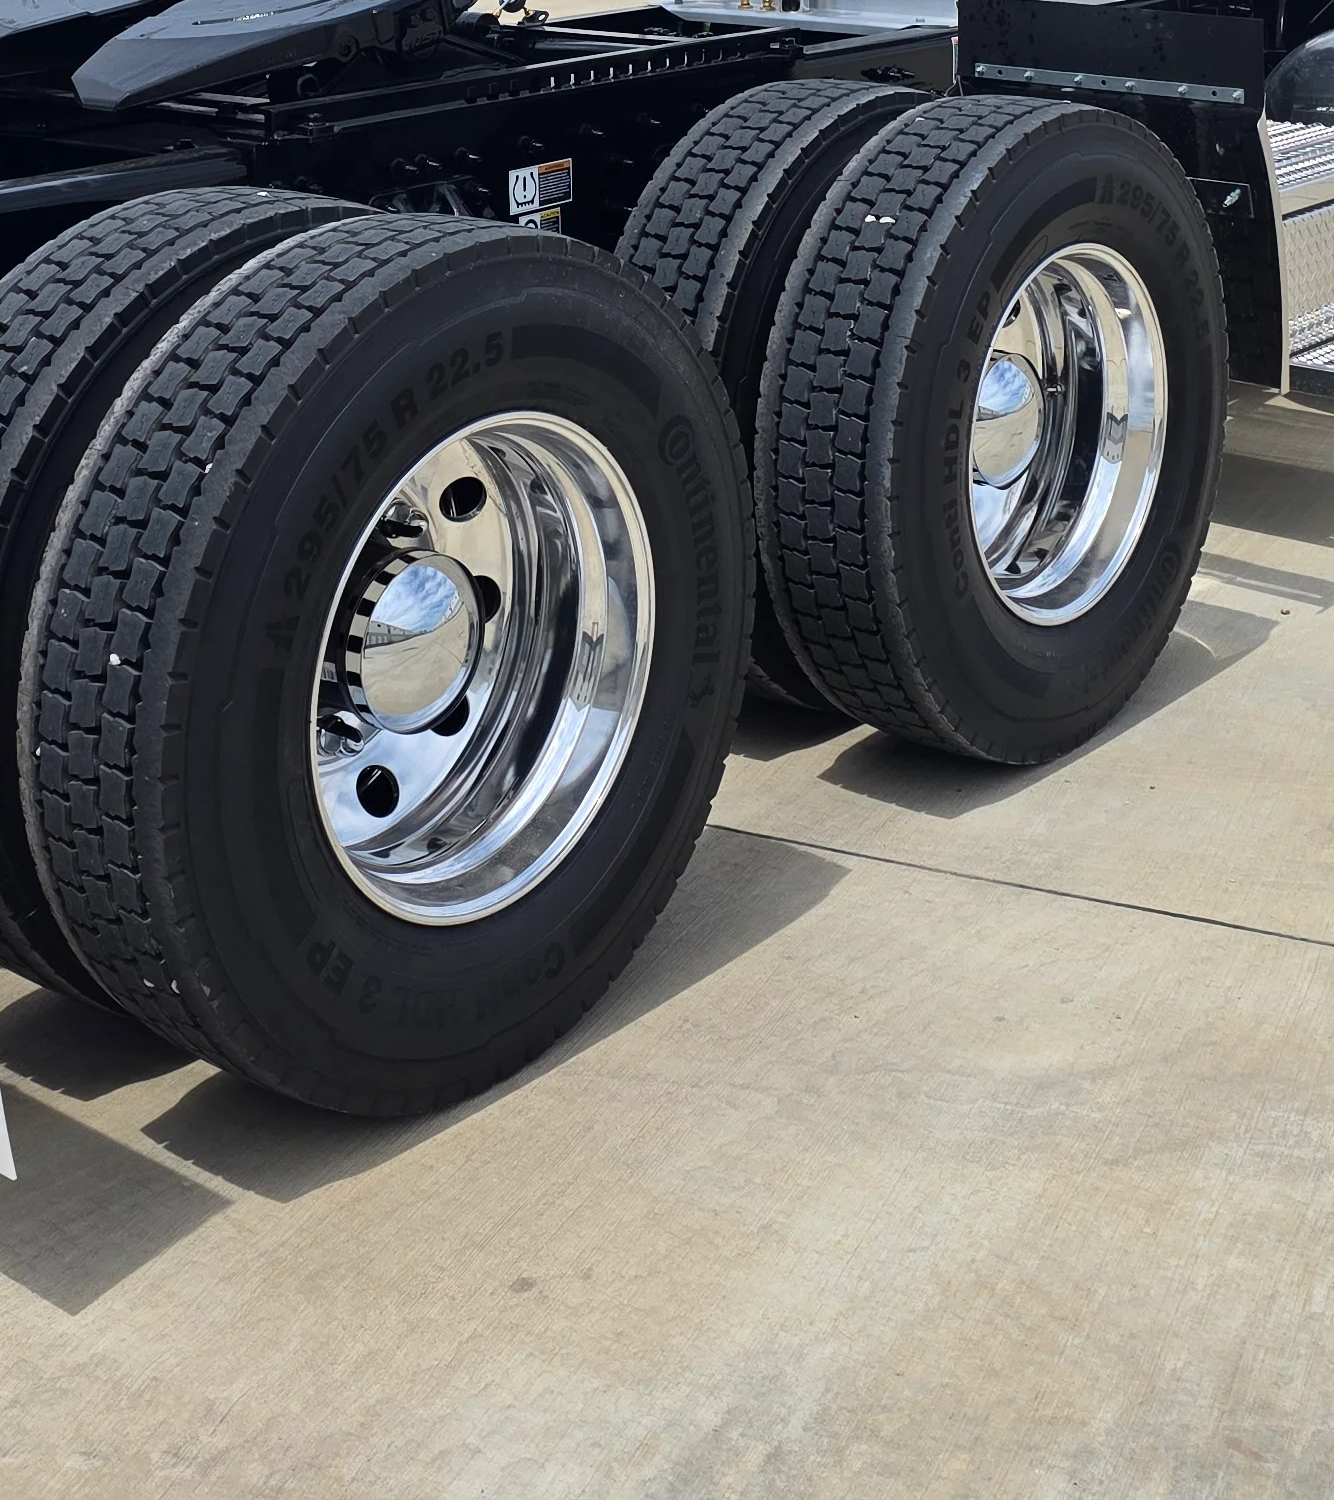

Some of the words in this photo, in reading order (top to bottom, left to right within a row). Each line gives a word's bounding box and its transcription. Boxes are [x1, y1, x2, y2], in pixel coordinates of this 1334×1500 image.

[1118, 176, 1178, 248] 295/75
[967, 290, 992, 346] EP
[956, 358, 972, 386] 3
[282, 417, 389, 602] 295/75
[389, 387, 420, 430] R
[424, 330, 505, 401] 22.5
[941, 400, 966, 489] HDL
[656, 413, 721, 666] Continental
[942, 508, 969, 600] Conti
[305, 940, 355, 996] EP
[357, 975, 383, 1015] 3
